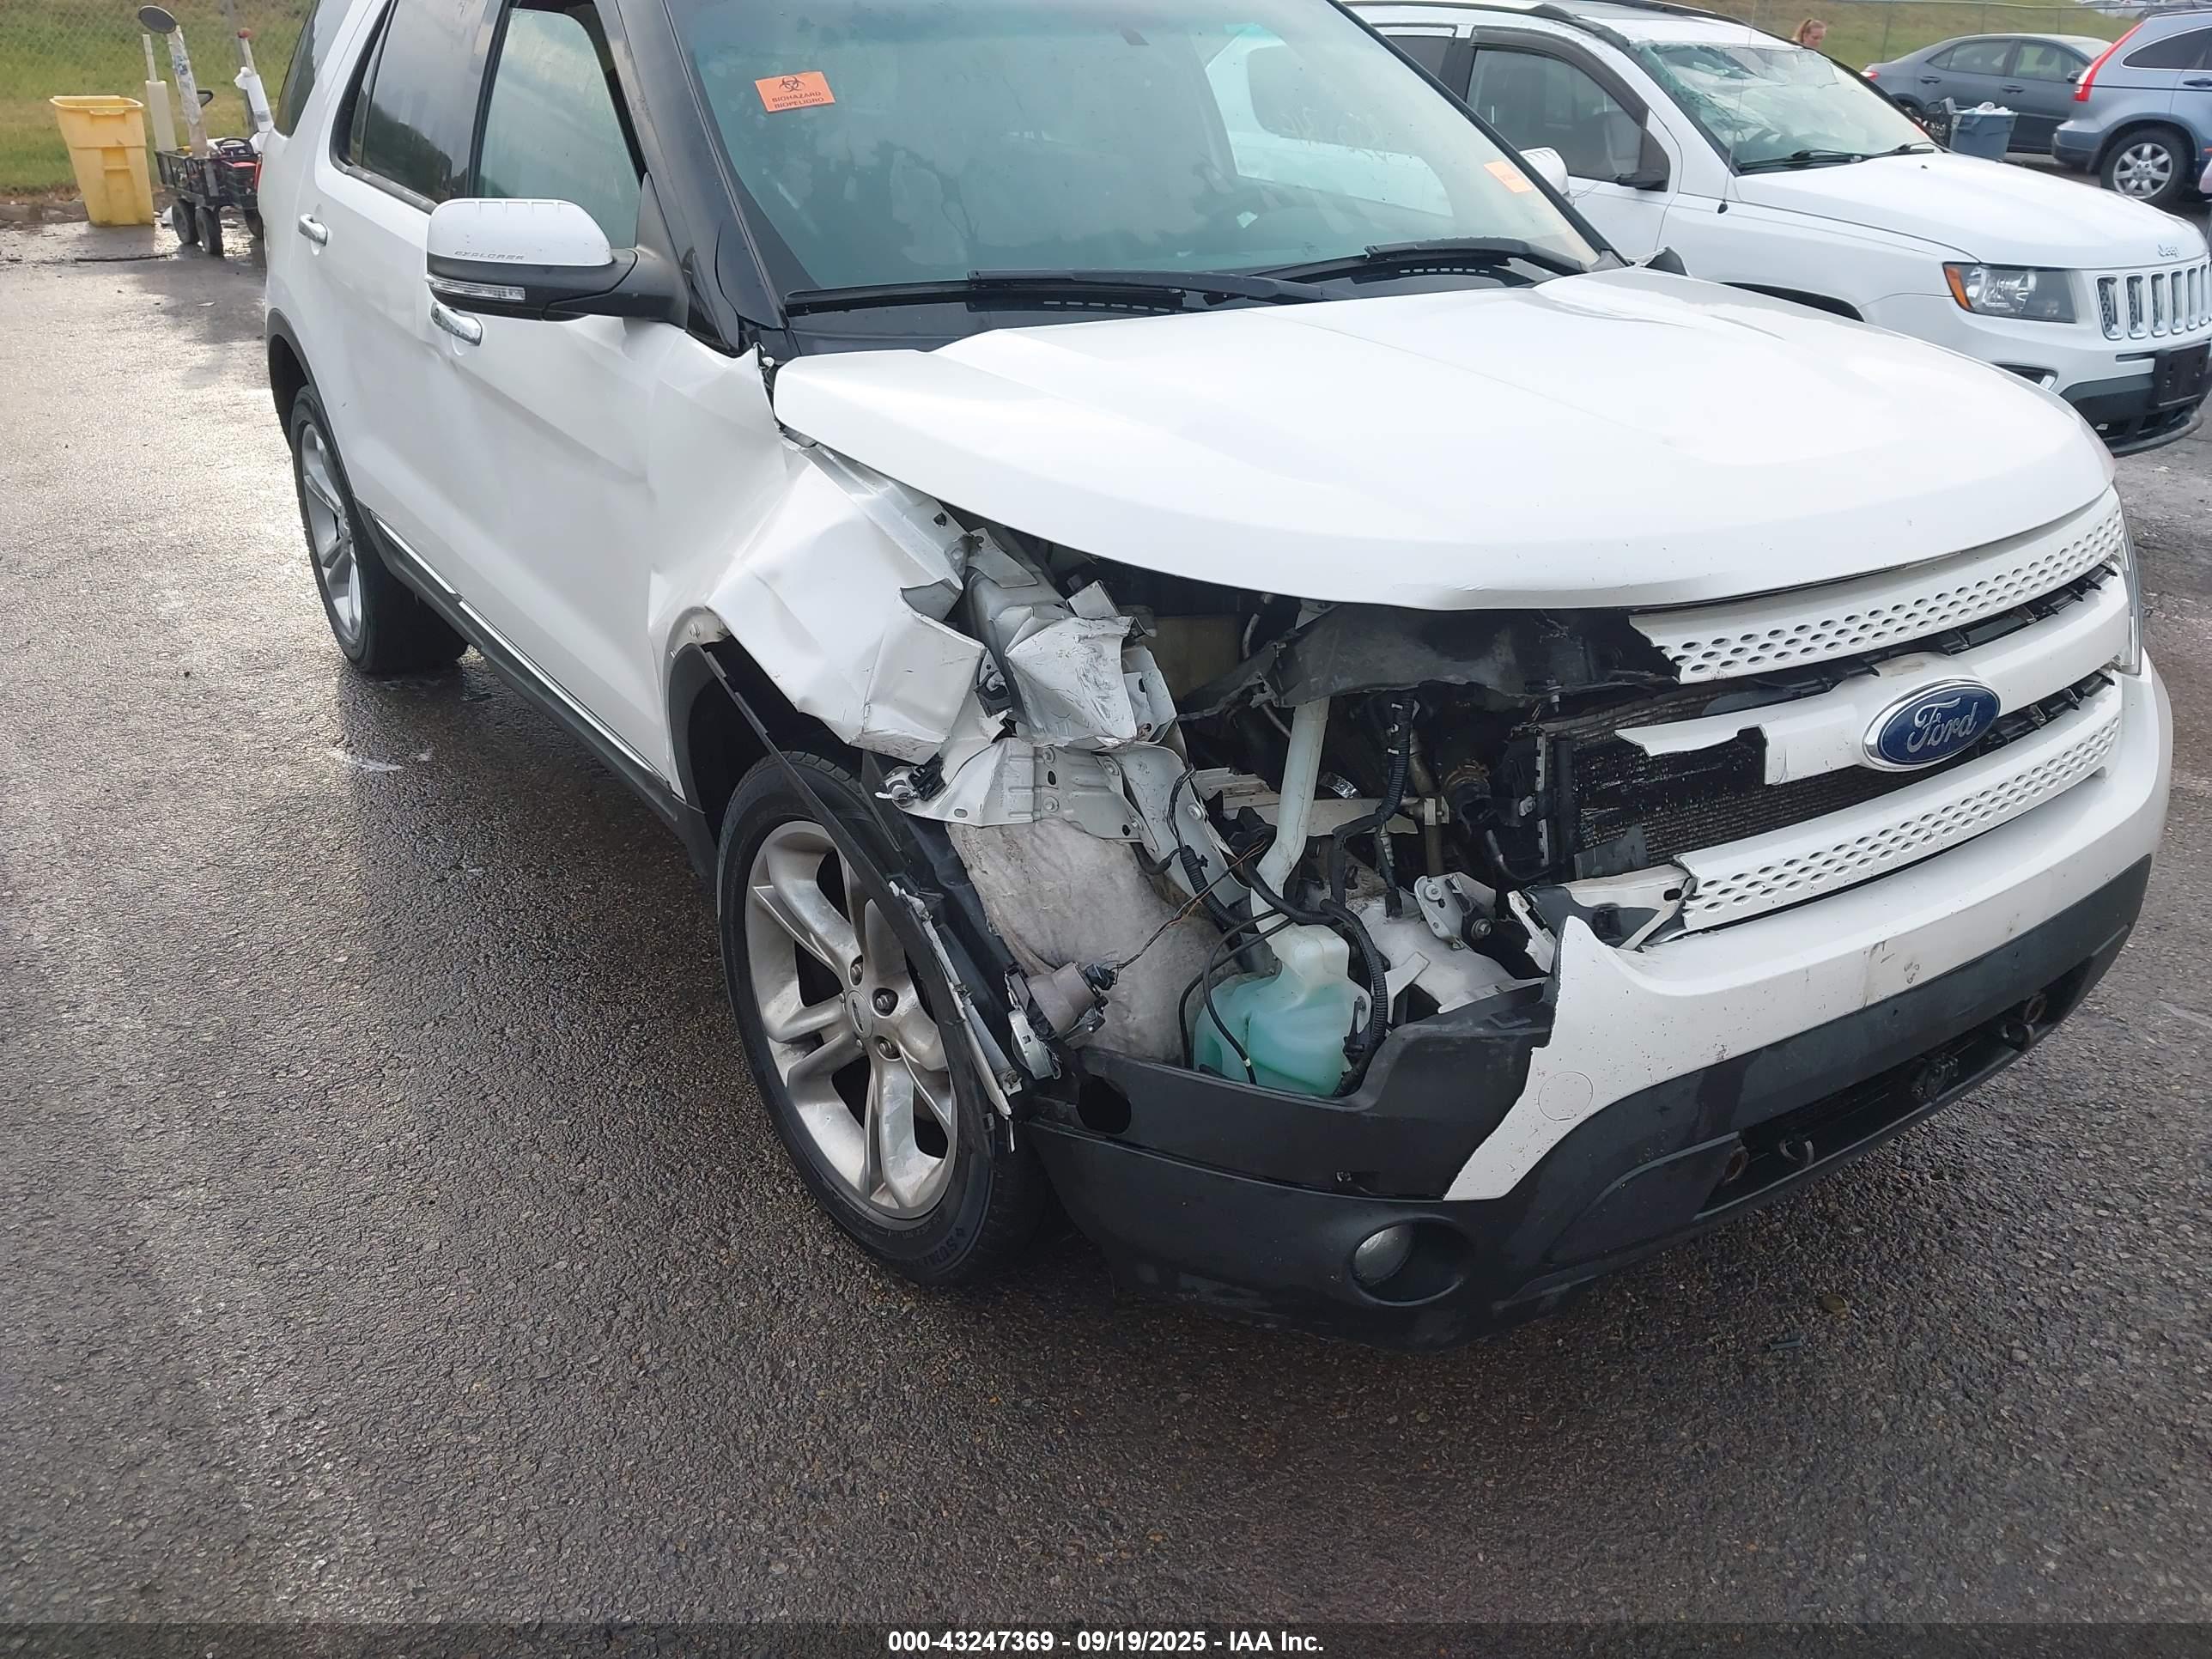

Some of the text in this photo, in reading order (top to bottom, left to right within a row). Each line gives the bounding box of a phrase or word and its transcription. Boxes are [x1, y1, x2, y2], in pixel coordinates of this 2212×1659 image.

[772, 91, 822, 103] BIOHAZARD
[775, 97, 824, 109] BIOPELIGRO
[453, 251, 525, 260] EXPLORER
[1906, 696, 1978, 753] Ford
